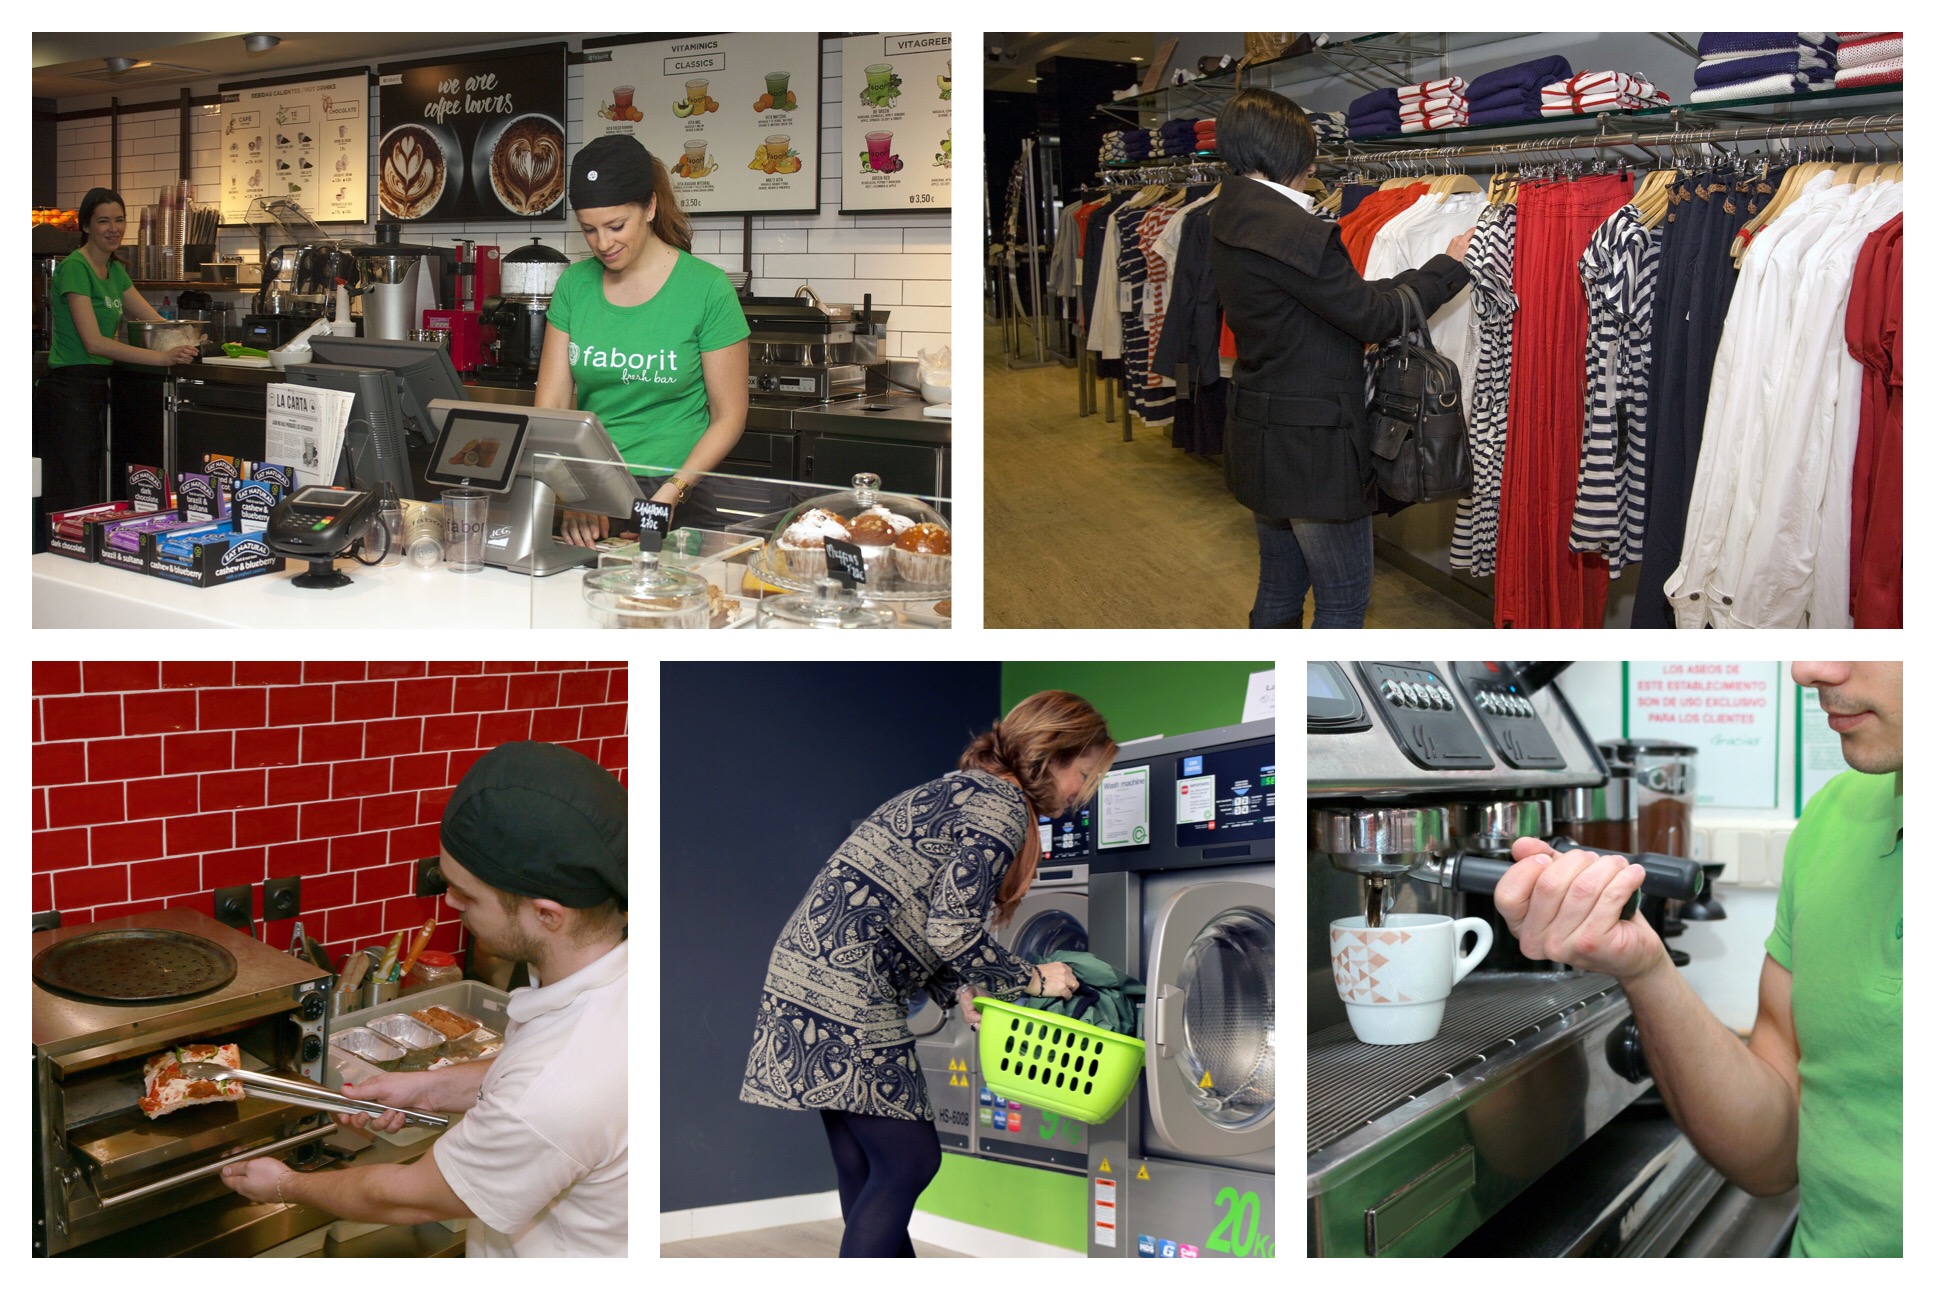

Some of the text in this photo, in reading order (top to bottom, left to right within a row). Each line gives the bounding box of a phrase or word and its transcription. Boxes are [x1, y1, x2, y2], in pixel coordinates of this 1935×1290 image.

[671, 41, 718, 52] VITAMINICS
[675, 59, 714, 70] CLASSICS
[273, 88, 300, 97] CALIENTES
[316, 84, 336, 92] DRINKS
[438, 73, 498, 94] we are
[328, 106, 357, 115] CHOCOLATE
[424, 93, 513, 124] coffee lovers
[583, 345, 678, 371] faborit
[621, 368, 676, 385] fresh bar
[276, 394, 308, 412] LA CARTA
[140, 472, 159, 487] NATURAL
[266, 470, 287, 486] NATURAL
[140, 486, 152, 495] dark
[191, 482, 212, 496] NATURAL
[238, 488, 272, 504] EAT NATURAL
[134, 494, 159, 504] chocolate
[186, 496, 208, 506] brazil &
[188, 504, 208, 513] sultana
[242, 504, 268, 514] cashew &
[241, 510, 270, 522] blueberry
[50, 540, 86, 554] dark chocolate
[225, 542, 266, 562] EAT NATURAL
[102, 549, 144, 566] brazil & sultana
[150, 561, 169, 571] cashew
[169, 564, 174, 572] &
[174, 566, 202, 580] blueberry
[214, 557, 276, 577] cashew & blueberry
[1662, 664, 1740, 674] LOS ASEOS DE
[1637, 681, 1767, 692] ESTE ESTABLECIMIENTO
[1637, 697, 1767, 708] SON DE USO EXCLUSIVO
[1648, 713, 1755, 724] PARA LOS CLIENTES
[1104, 778, 1145, 790] Wash machine
[939, 1108, 970, 1127] HS-6008
[1205, 1186, 1261, 1258] 20
